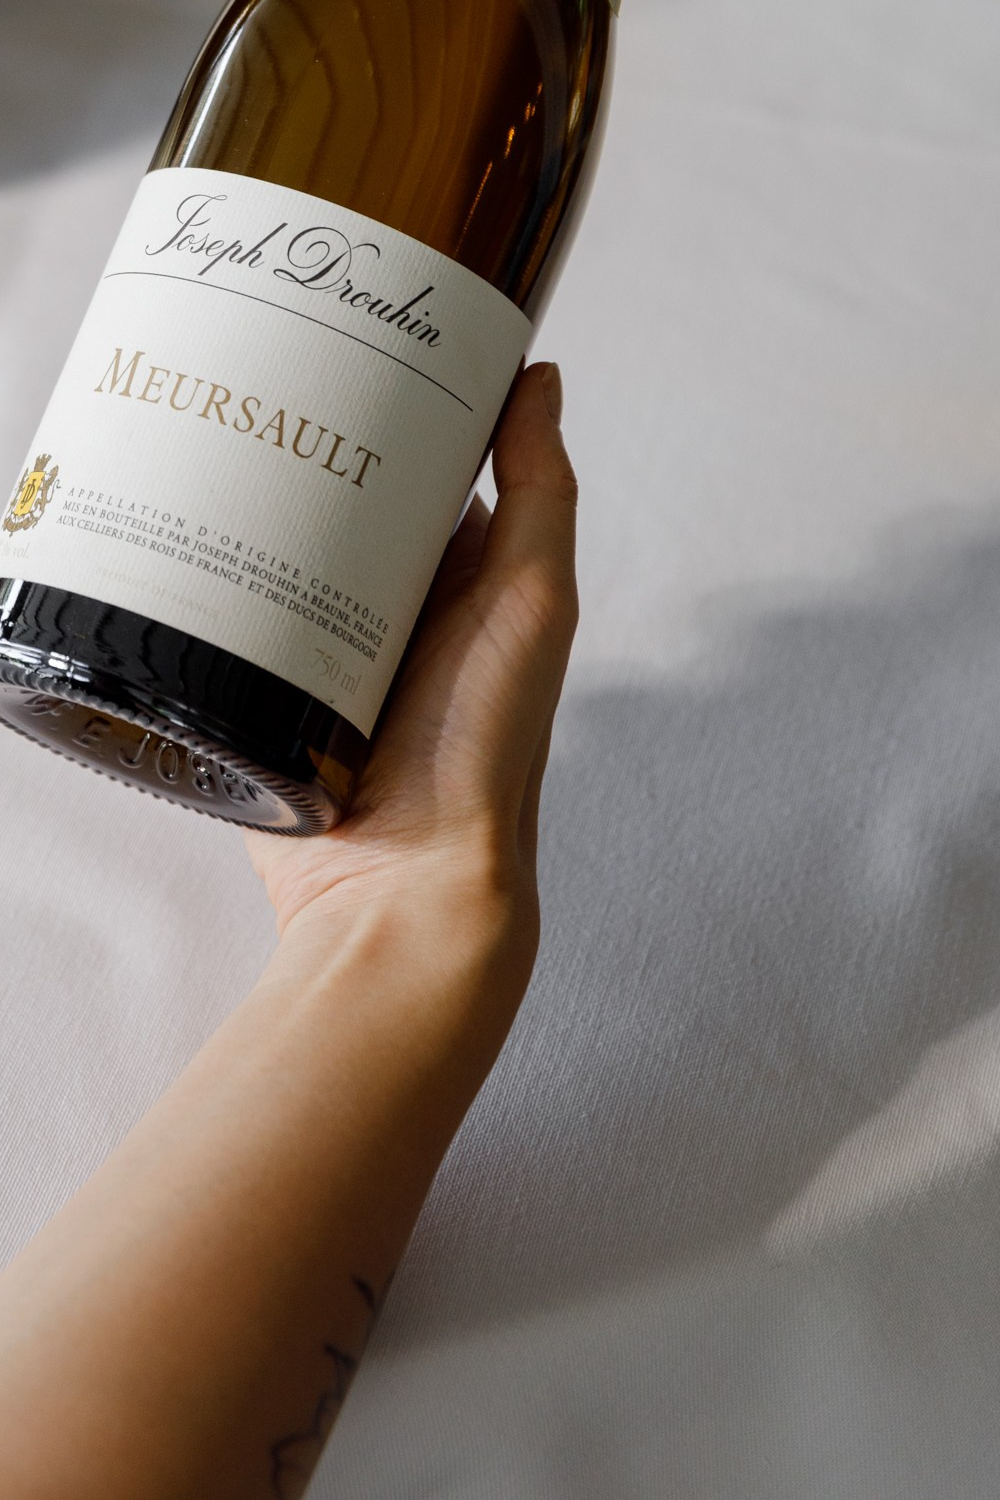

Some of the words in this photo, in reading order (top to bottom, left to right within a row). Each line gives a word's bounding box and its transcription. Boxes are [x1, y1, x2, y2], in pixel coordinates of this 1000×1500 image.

[145, 194, 288, 276] Joseph
[273, 226, 442, 348] Drouhin
[94, 348, 382, 488] MEURSAULT
[56, 514, 76, 527] AUX
[76, 519, 124, 541] CELLIERS
[125, 533, 151, 548] DES
[150, 540, 177, 558] ROIS
[178, 550, 196, 565] DE
[196, 558, 244, 585] FRANCE
[247, 580, 265, 594] ET
[265, 588, 288, 606] DES
[287, 599, 317, 622] DUCS
[316, 615, 331, 631] DE
[330, 624, 378, 662] BOURGOGNE
[62, 500, 80, 514] MIS
[82, 503, 98, 517] EN
[100, 509, 163, 538] BOUTEILLE
[166, 530, 190, 547] PAR
[192, 540, 239, 567] JOSEPH
[241, 561, 300, 595] DROUHIN
[311, 595, 351, 627] BEAUNE,
[353, 621, 383, 648] FRANCE
[67, 487, 186, 529] APPELLATION
[197, 525, 301, 579] D'ORIGINE
[310, 578, 389, 634] CONTRÔLÉE
[311, 648, 342, 682] 750
[340, 671, 363, 696] ml
